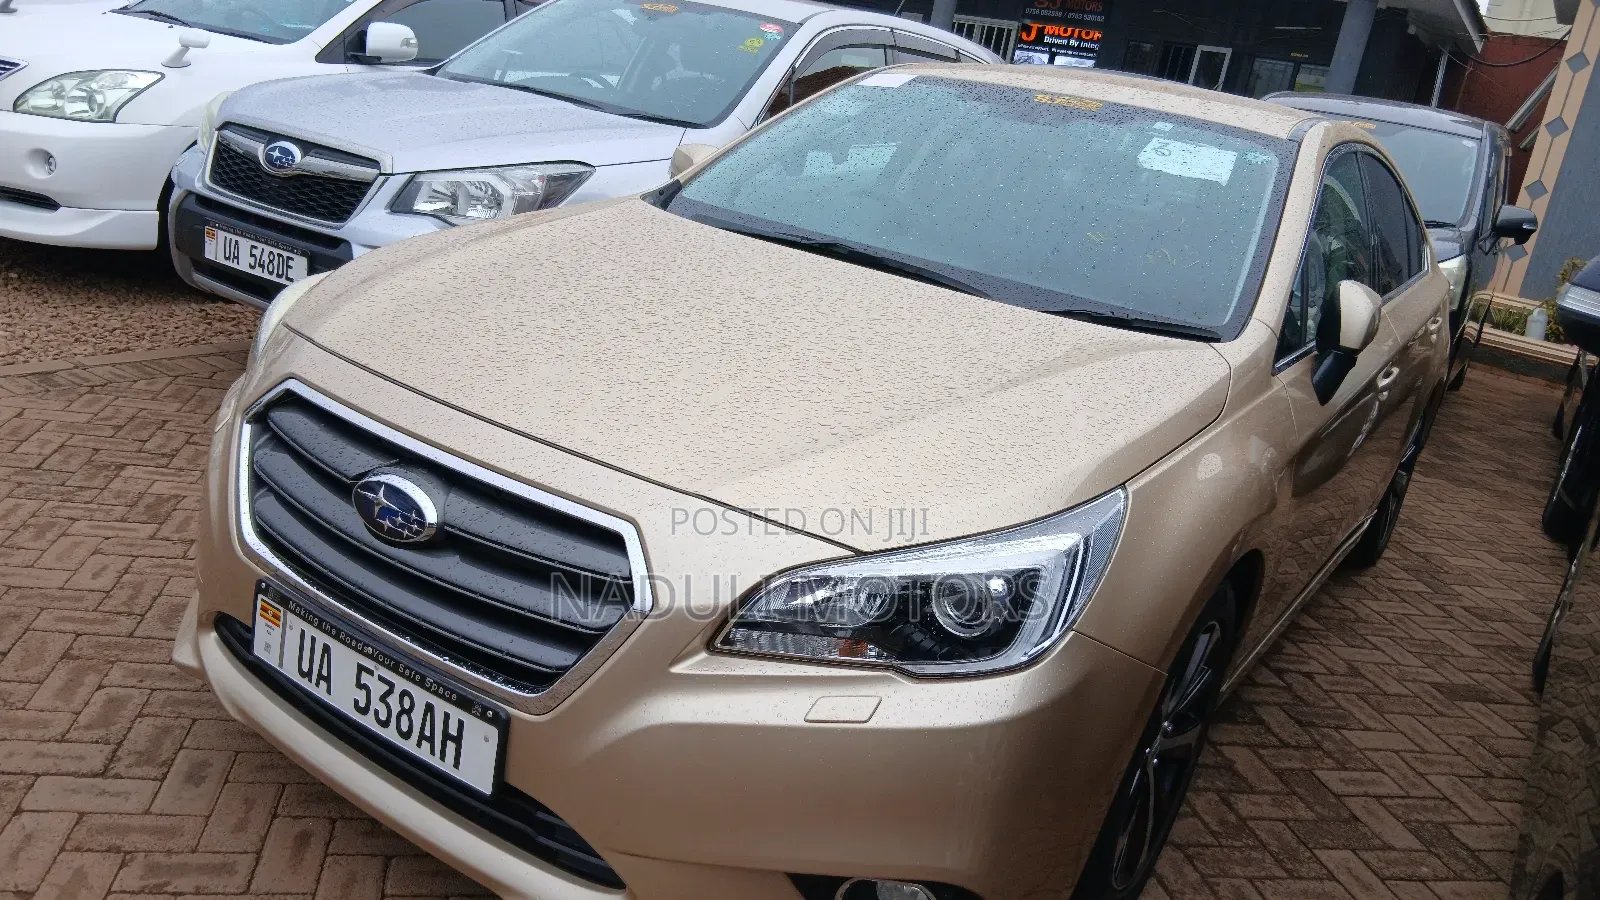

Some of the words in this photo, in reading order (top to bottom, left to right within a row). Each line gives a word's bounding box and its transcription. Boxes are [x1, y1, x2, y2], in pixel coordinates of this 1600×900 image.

[1044, 36, 1067, 45] Driven
[1069, 39, 1079, 47] By
[224, 236, 240, 265] UA
[249, 245, 294, 282] 548DE
[288, 600, 319, 627] Making
[322, 620, 336, 636] the
[373, 648, 396, 667] Your
[398, 663, 421, 682] Safe
[425, 677, 458, 701] Space
[297, 628, 333, 696] UA
[353, 662, 465, 771] 538AH
